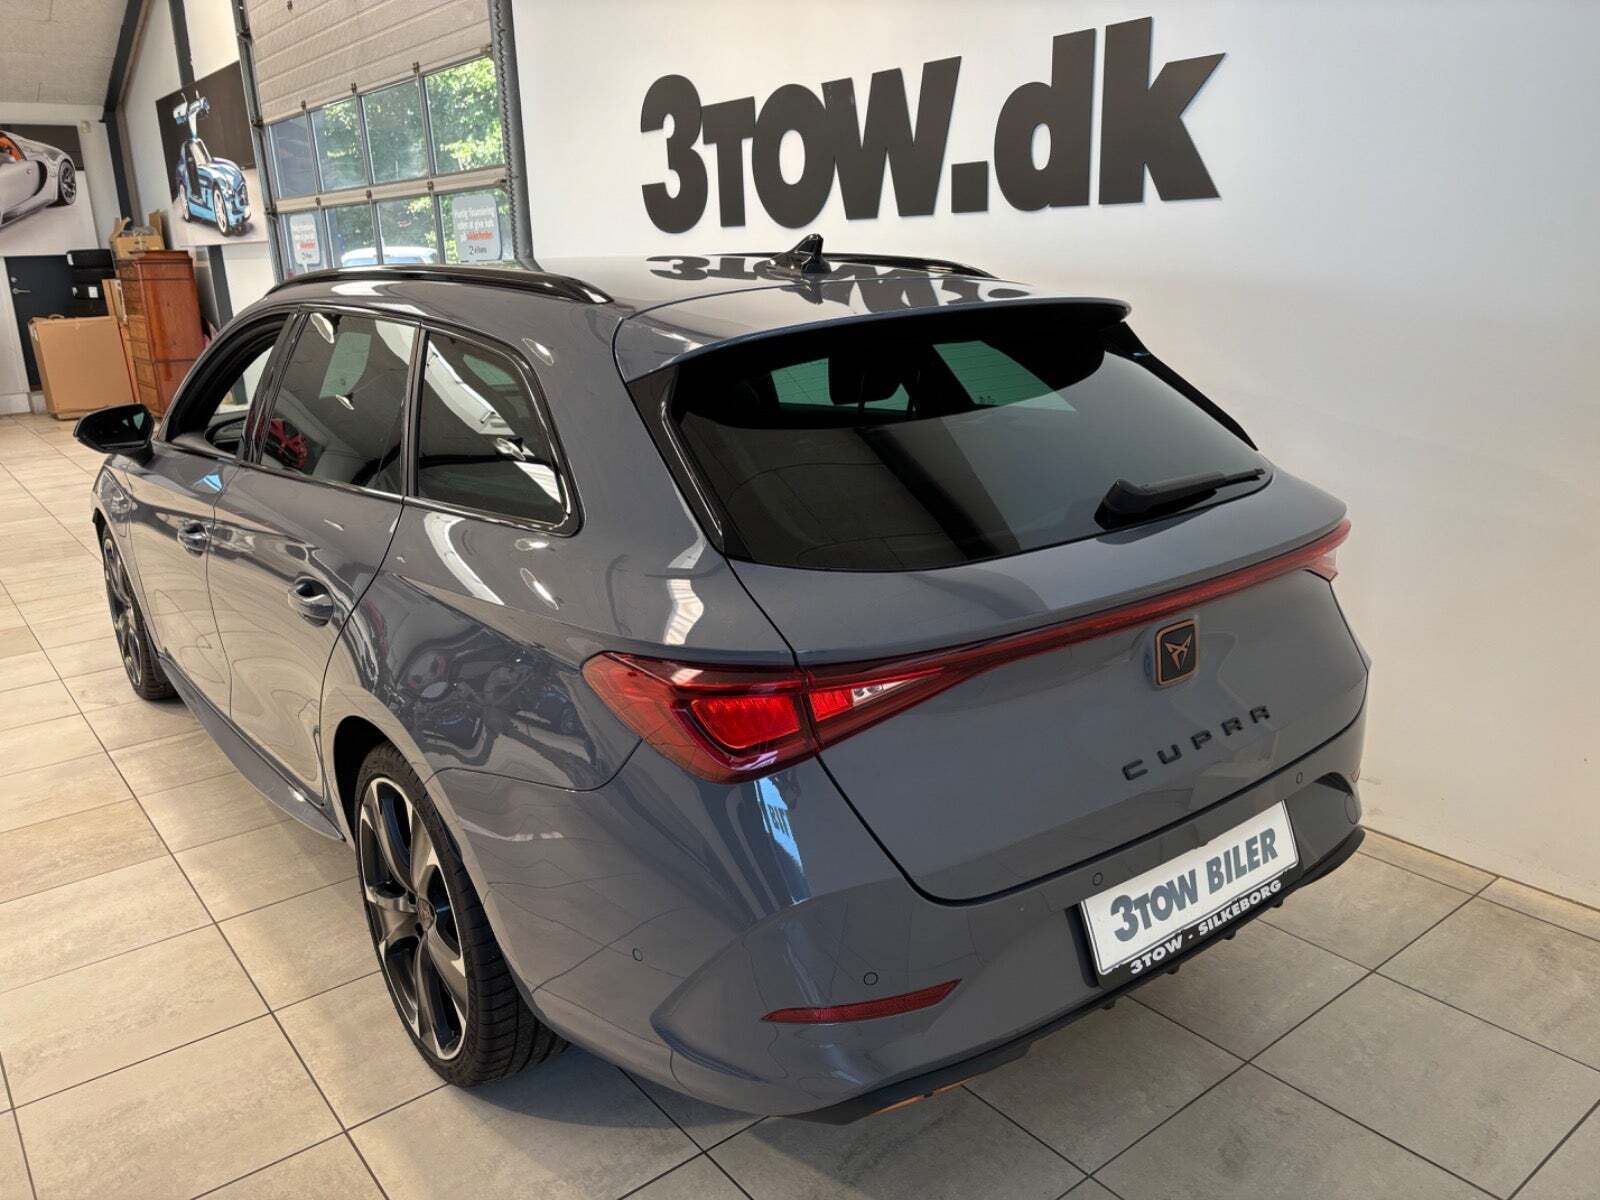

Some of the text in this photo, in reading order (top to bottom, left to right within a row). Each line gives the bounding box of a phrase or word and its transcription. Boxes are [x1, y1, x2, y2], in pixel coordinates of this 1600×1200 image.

[640, 16, 1226, 234] 3TOW.dk
[1122, 704, 1271, 781] CUPRA
[1110, 828, 1278, 942] 3TOW BILER
[1130, 935, 1183, 974] 3TOW
[1198, 880, 1282, 935] SILKEBORG
